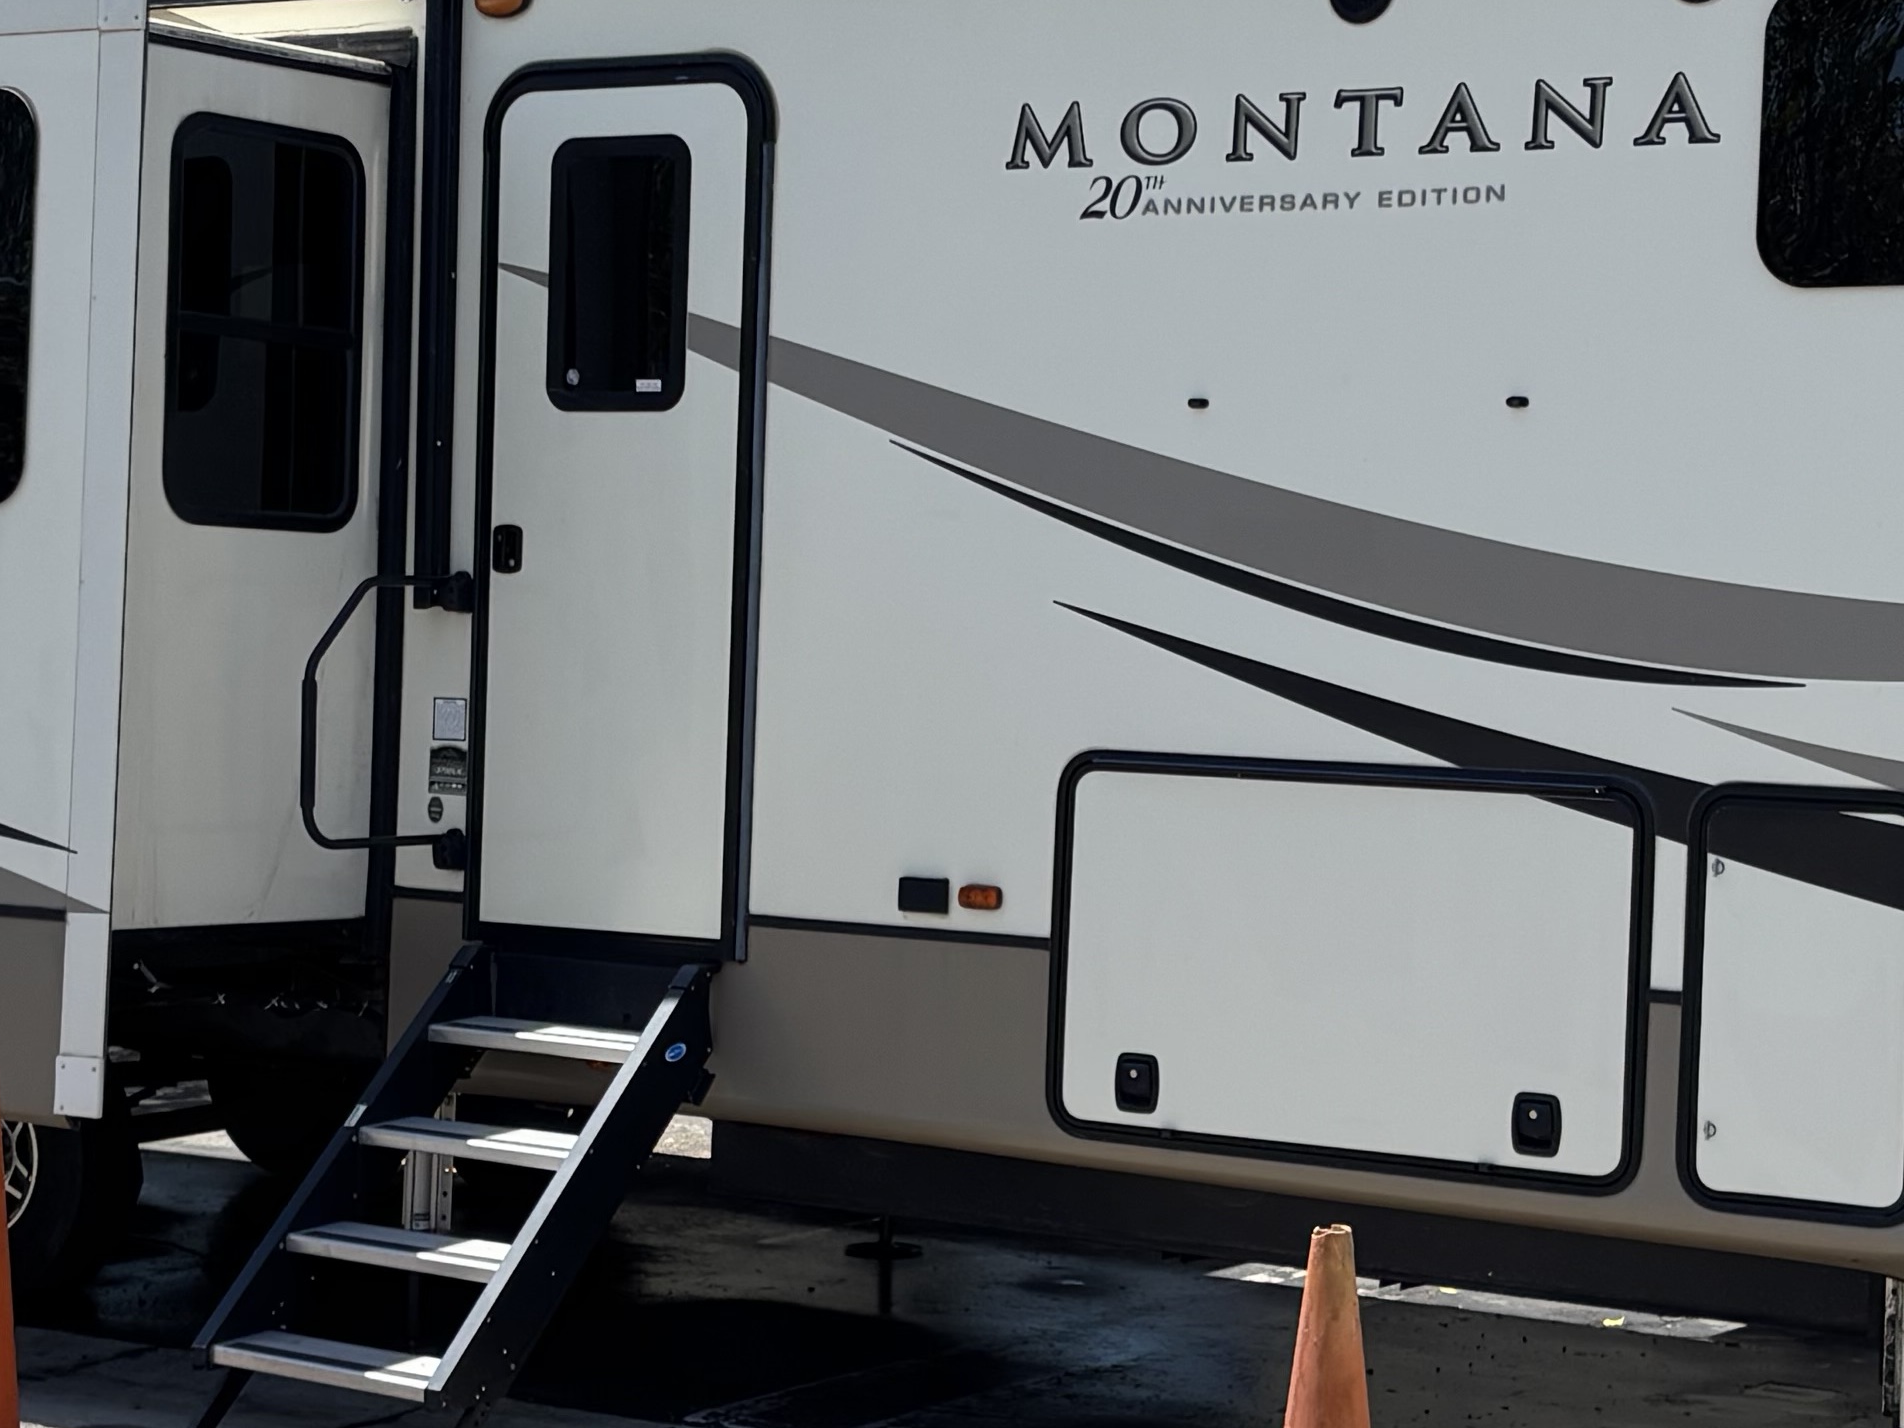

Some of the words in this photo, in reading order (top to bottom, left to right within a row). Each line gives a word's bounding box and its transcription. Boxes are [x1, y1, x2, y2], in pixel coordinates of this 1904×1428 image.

[1004, 71, 1721, 170] MONTANA
[1140, 191, 1362, 217] ANNIVERSARY
[1377, 183, 1507, 209] EDITION
